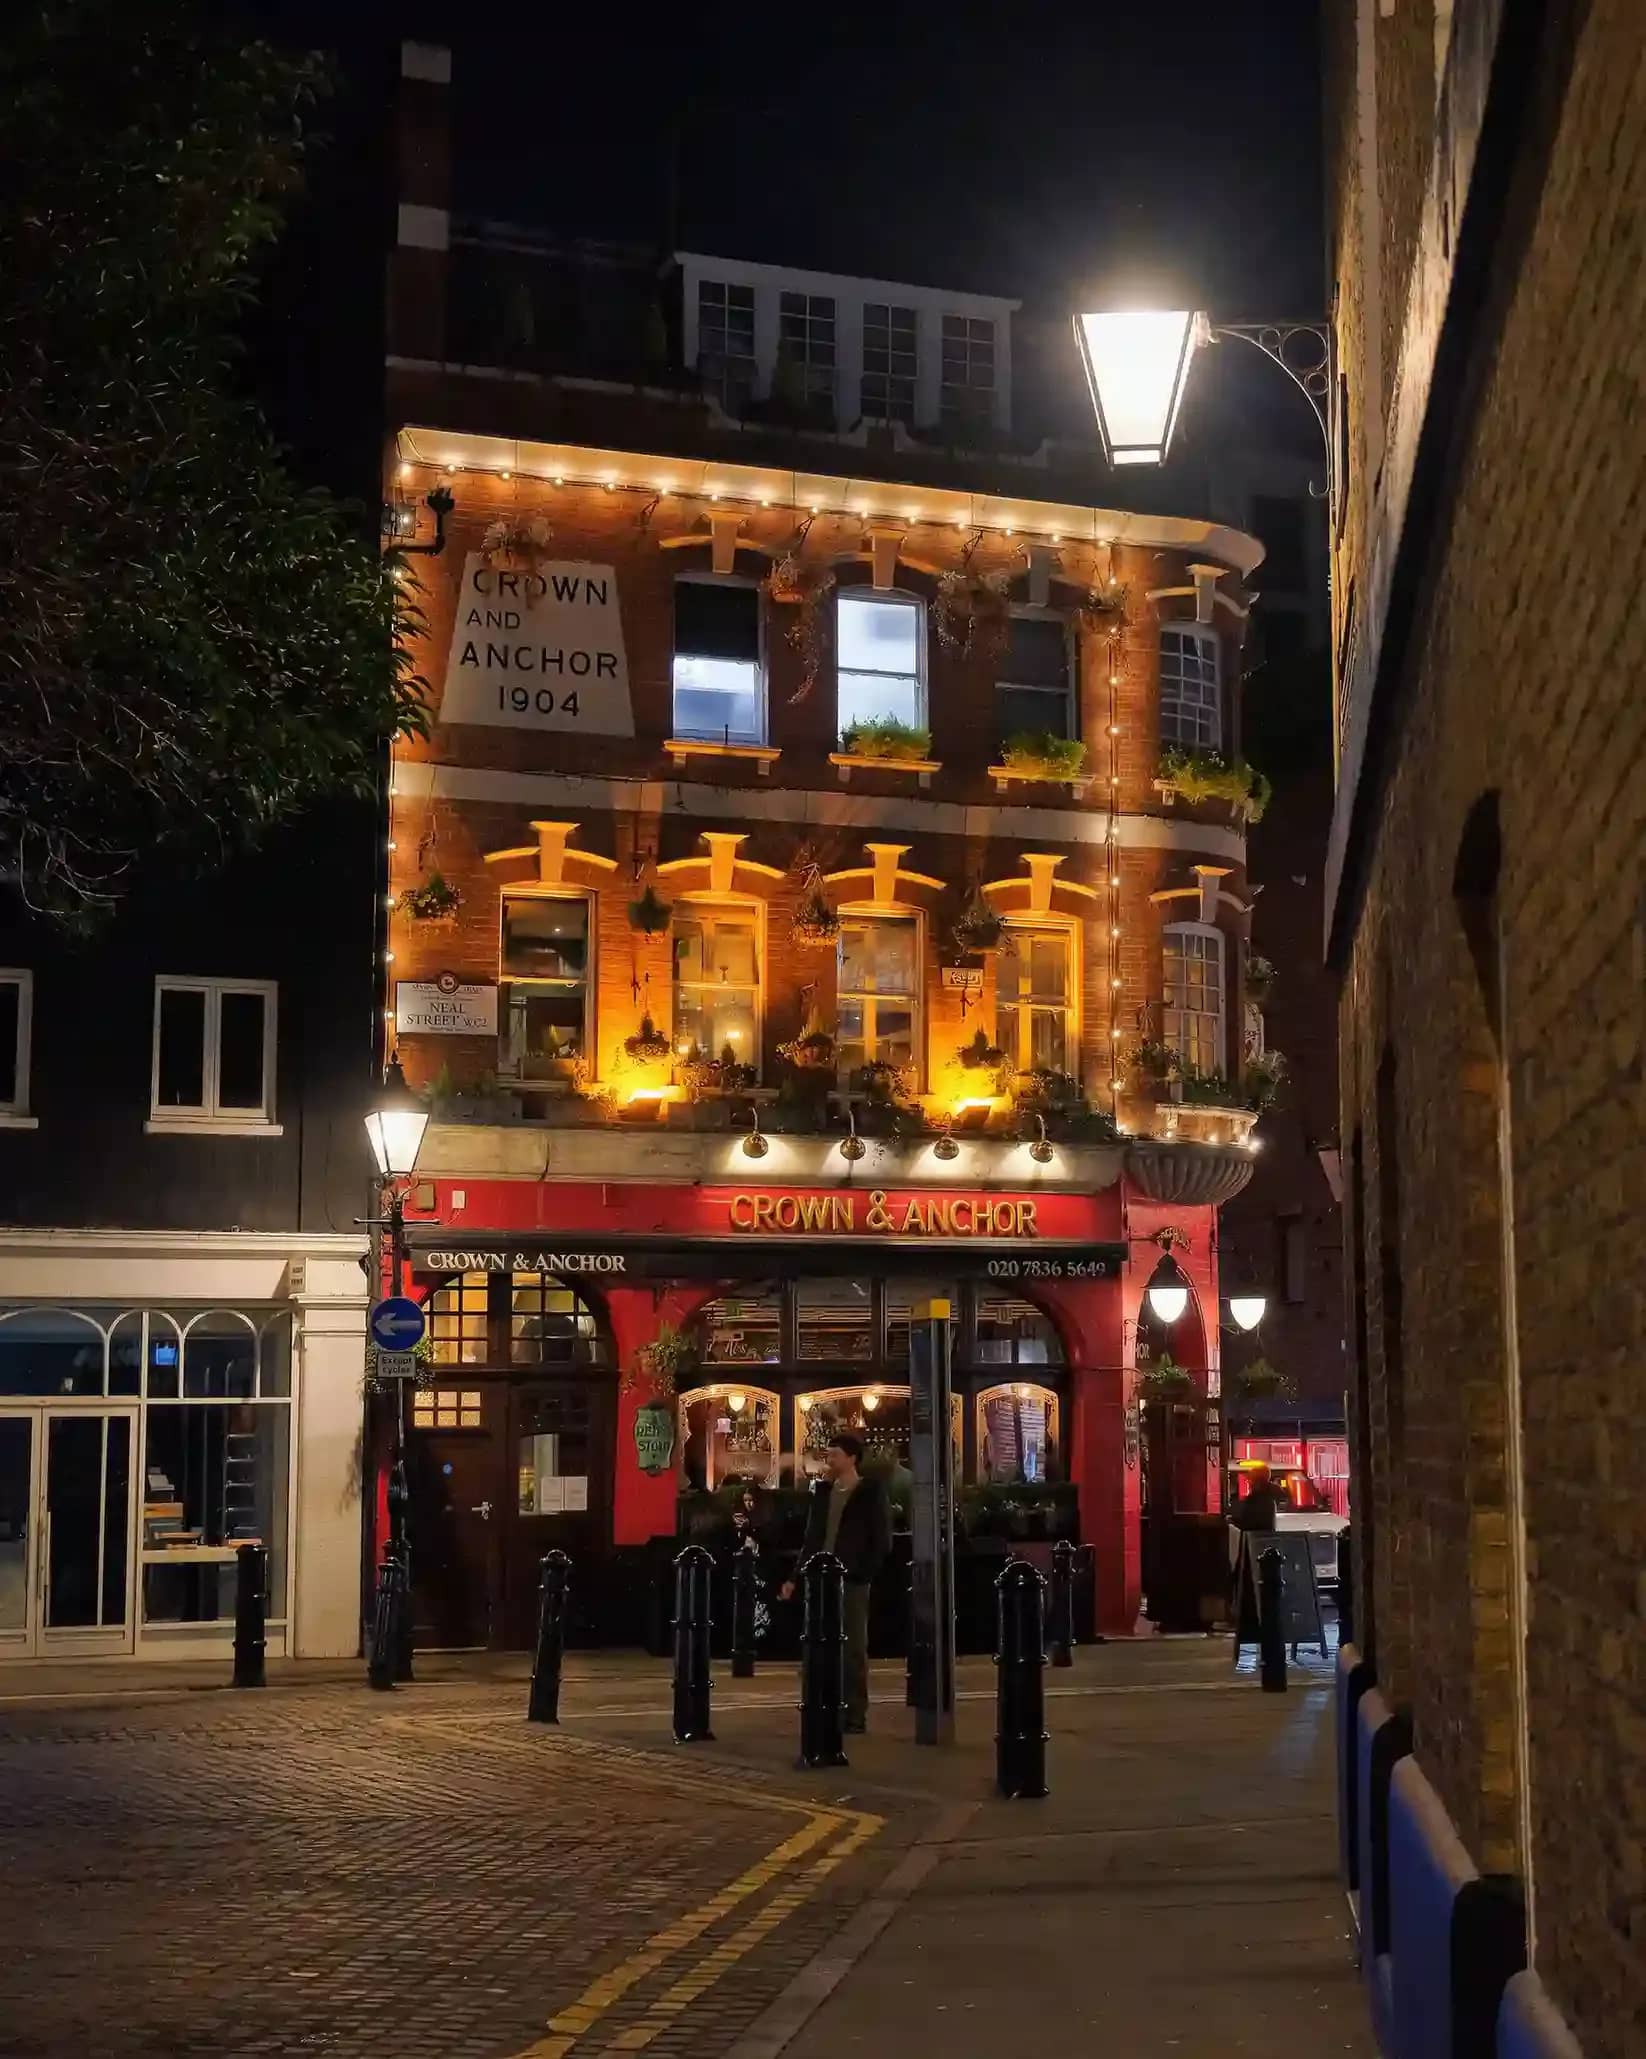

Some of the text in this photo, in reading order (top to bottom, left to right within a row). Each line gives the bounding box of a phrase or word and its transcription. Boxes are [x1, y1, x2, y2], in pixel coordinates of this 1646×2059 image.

[473, 568, 608, 605] CROWN
[466, 608, 521, 630] AND
[460, 641, 618, 678] ANCHOR
[499, 685, 579, 717] 1904
[430, 1002, 465, 1014] NEAL
[406, 1015, 488, 1028] STREET WC2
[730, 1190, 1038, 1235] CROWN & ANCHOR
[427, 1252, 627, 1272] CROWN & ANCHOR
[987, 1260, 1106, 1277] 020 7836 5649
